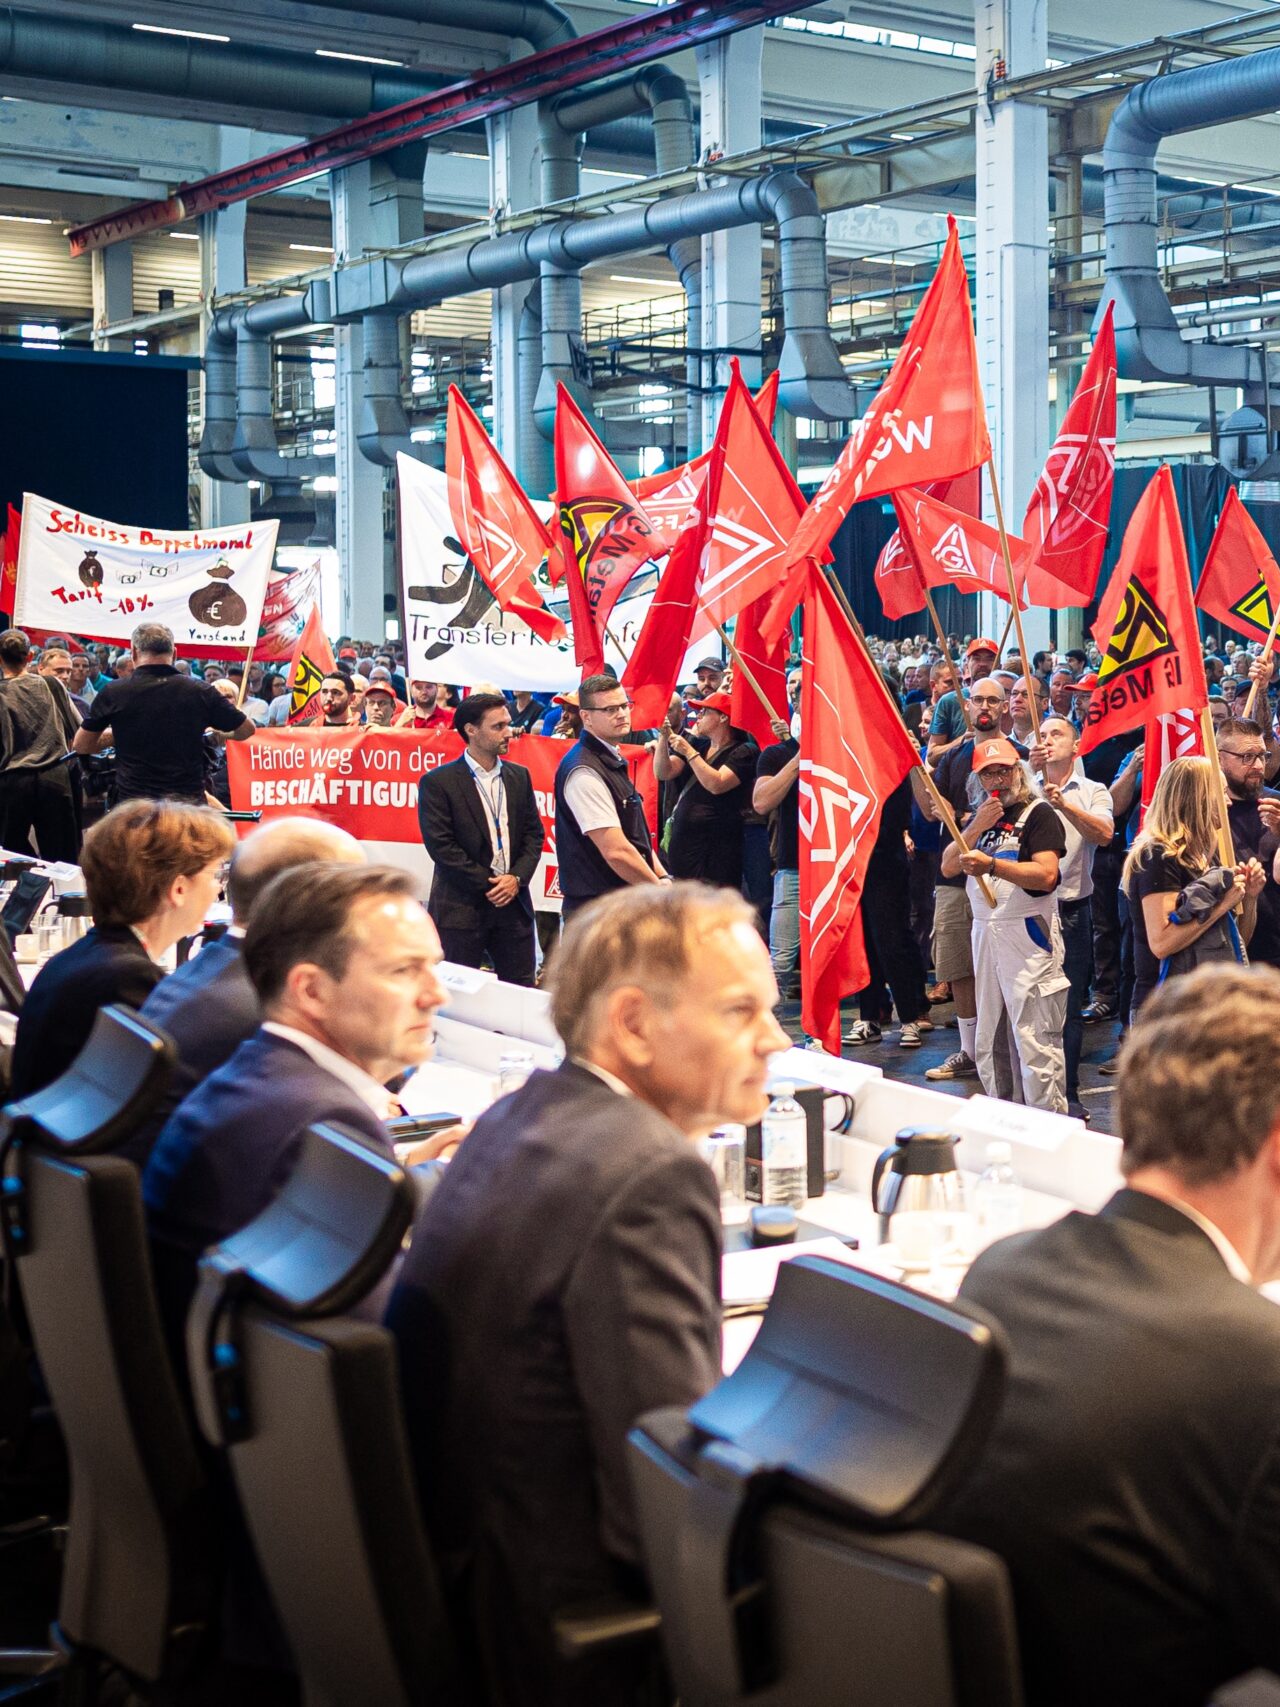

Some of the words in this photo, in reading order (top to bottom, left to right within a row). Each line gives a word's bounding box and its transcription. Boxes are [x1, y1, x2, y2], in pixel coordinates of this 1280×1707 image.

[46, 510, 129, 544] Scheiss
[140, 530, 253, 554] Doppelmoral
[51, 581, 102, 604] Tarif
[250, 743, 305, 770] Hände
[310, 748, 353, 775] weg
[361, 748, 401, 770] von
[409, 745, 446, 773] der
